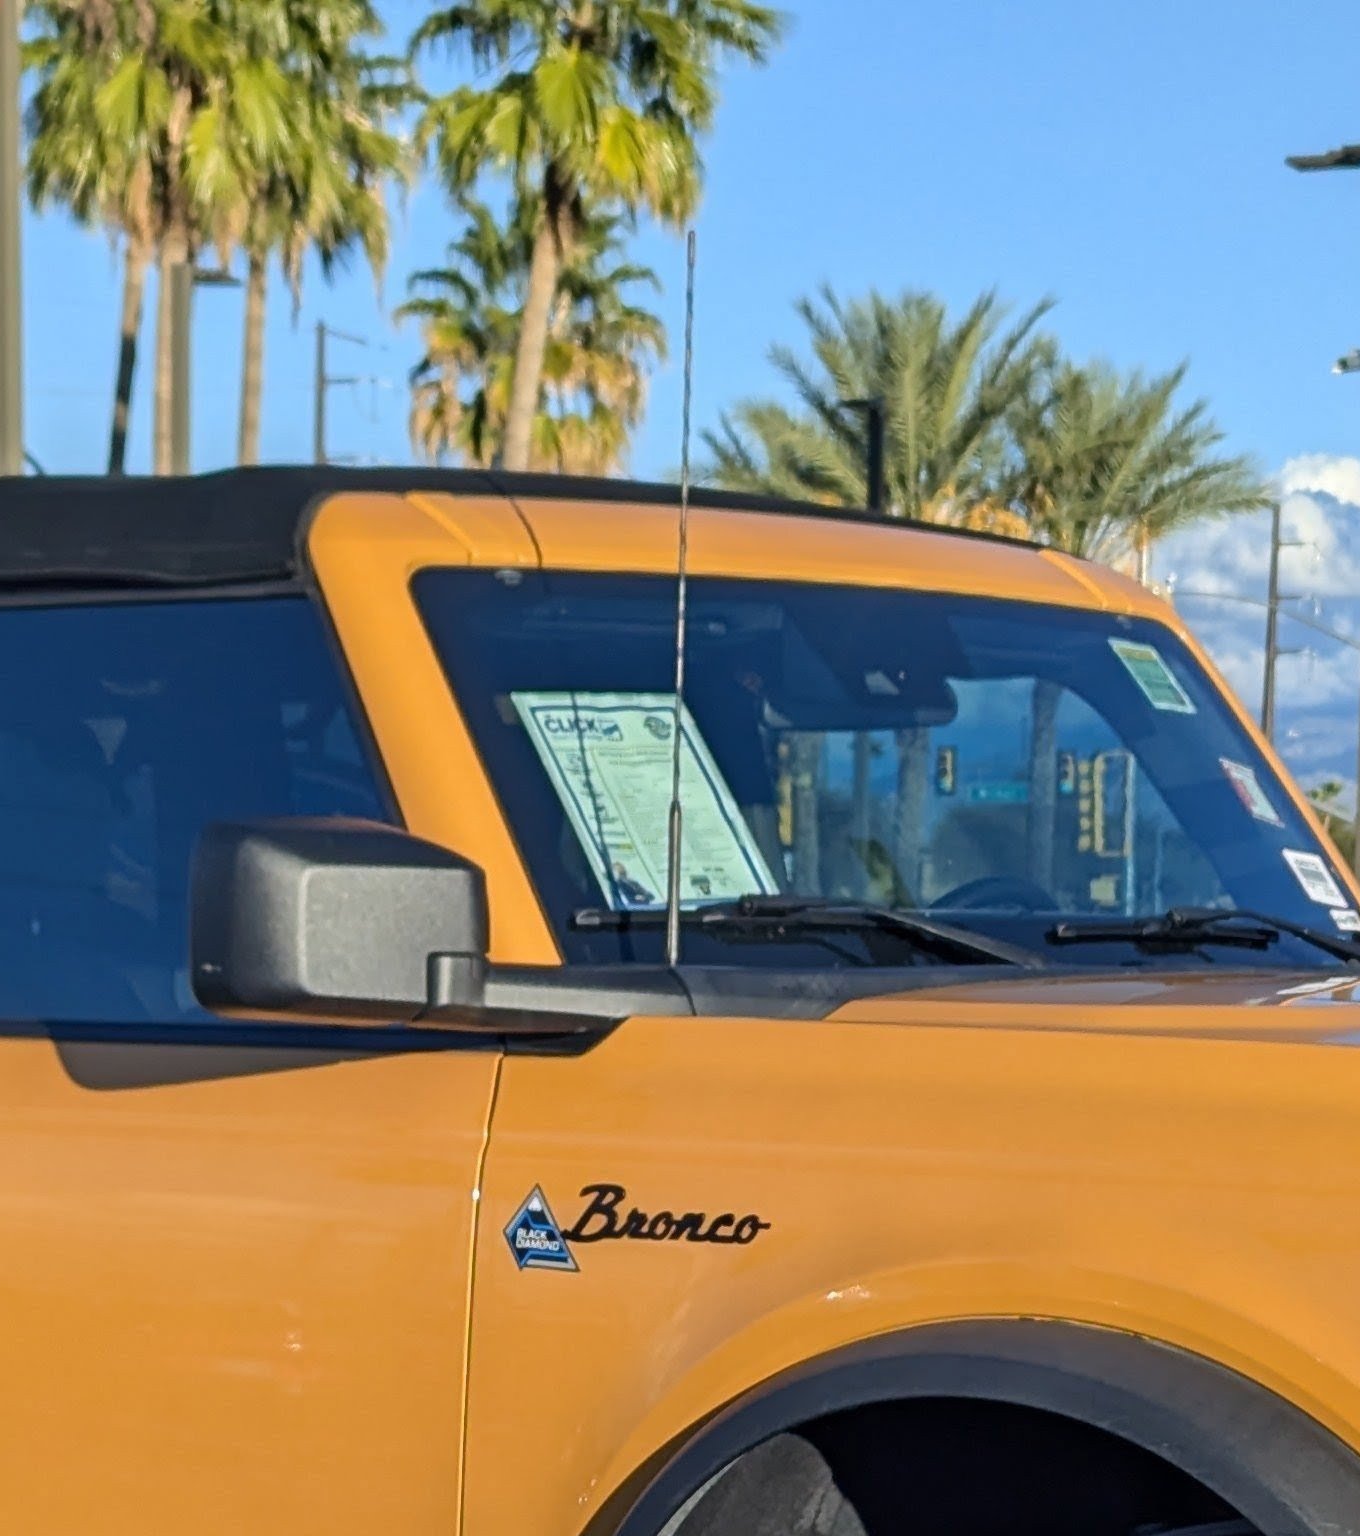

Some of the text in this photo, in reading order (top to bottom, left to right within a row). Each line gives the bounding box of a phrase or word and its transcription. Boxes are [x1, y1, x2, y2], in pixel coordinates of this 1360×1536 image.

[561, 1184, 771, 1244] Bronco
[516, 1228, 547, 1239] BLACK
[516, 1238, 560, 1250] DIAMOND
